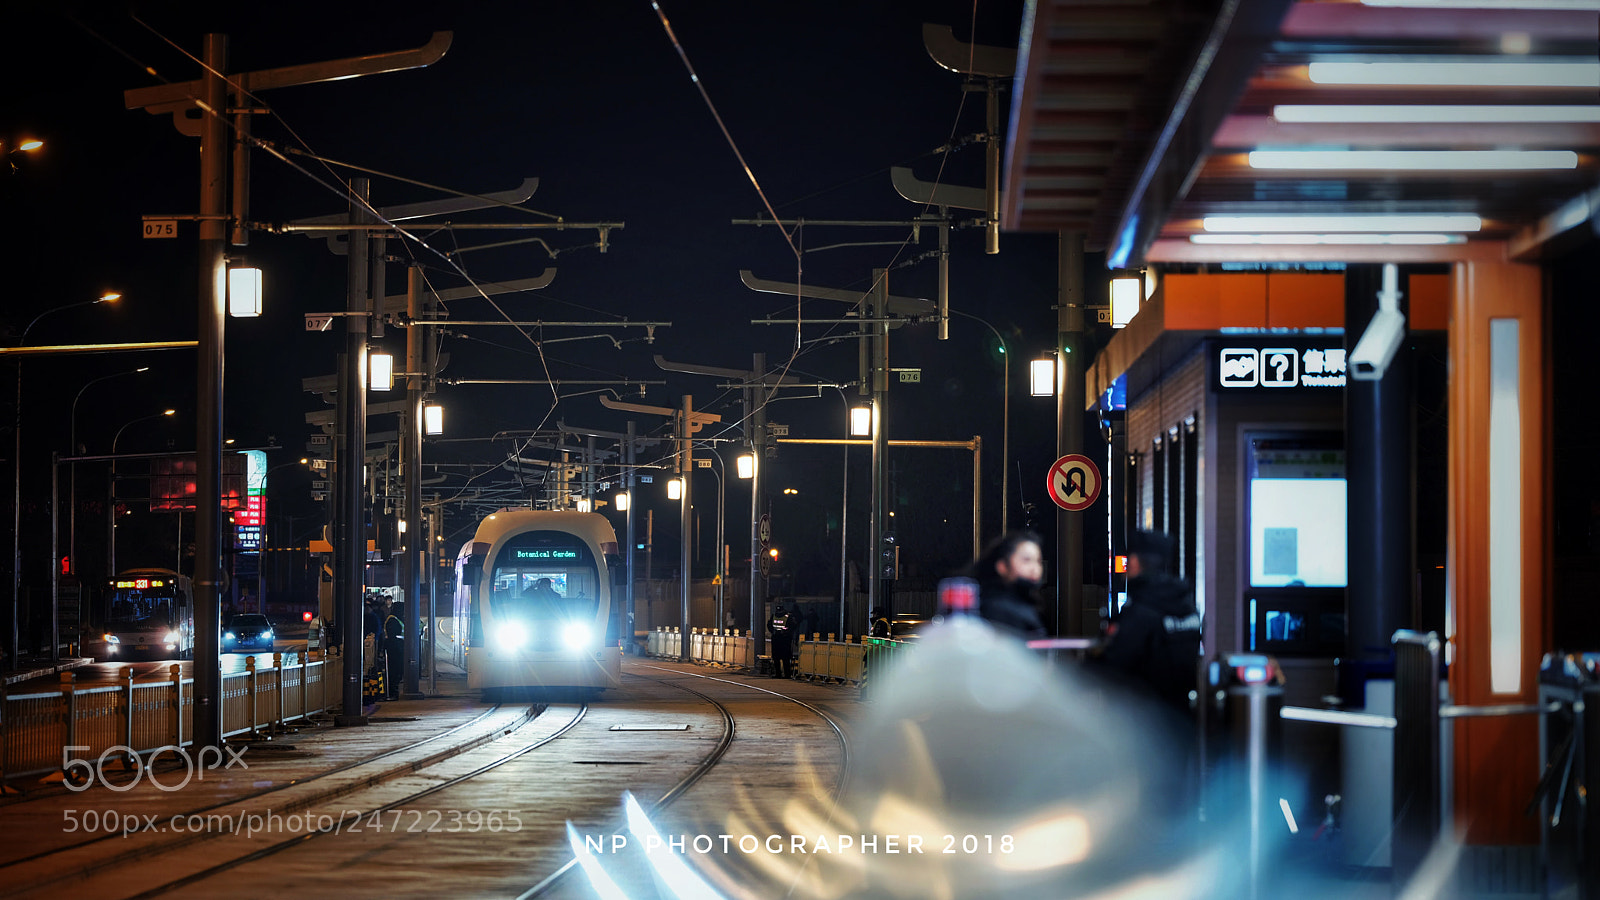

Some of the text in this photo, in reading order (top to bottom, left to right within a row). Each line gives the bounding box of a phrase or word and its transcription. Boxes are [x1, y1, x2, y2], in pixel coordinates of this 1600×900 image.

[145, 224, 173, 235] 075
[517, 550, 576, 558] Botanical Garden
[136, 580, 148, 588] 331
